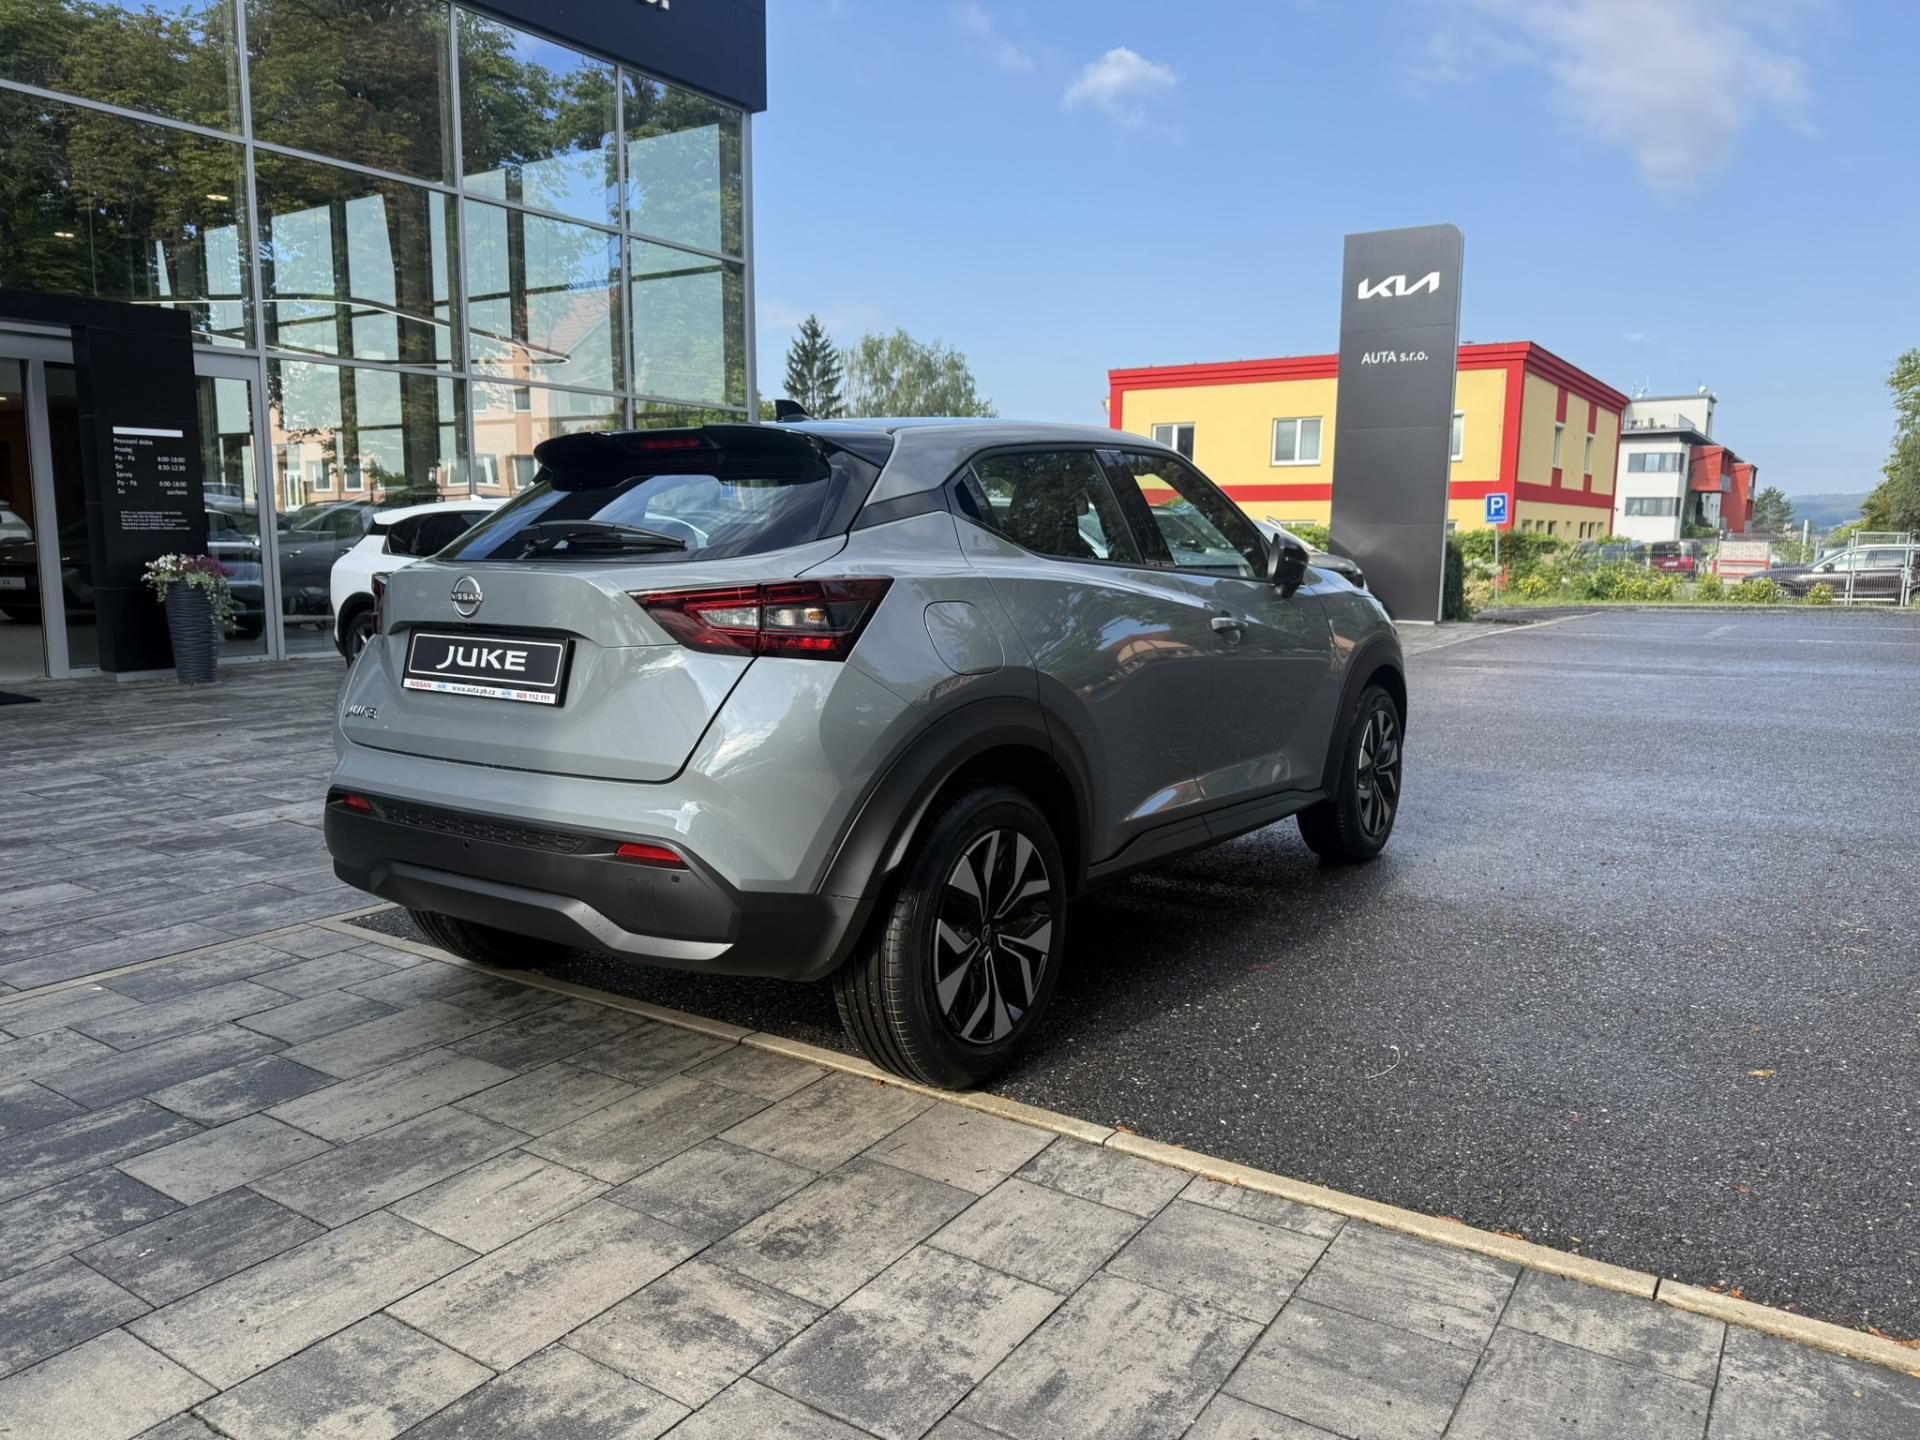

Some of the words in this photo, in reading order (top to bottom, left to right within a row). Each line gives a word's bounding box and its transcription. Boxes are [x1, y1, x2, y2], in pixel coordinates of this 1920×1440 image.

[1358, 272, 1440, 300] KIA
[1361, 350, 1397, 365] AUTA
[1399, 351, 1429, 362] s.r.o.
[1491, 497, 1504, 515] P
[451, 592, 484, 602] NISSAN
[435, 645, 529, 672] JUKE
